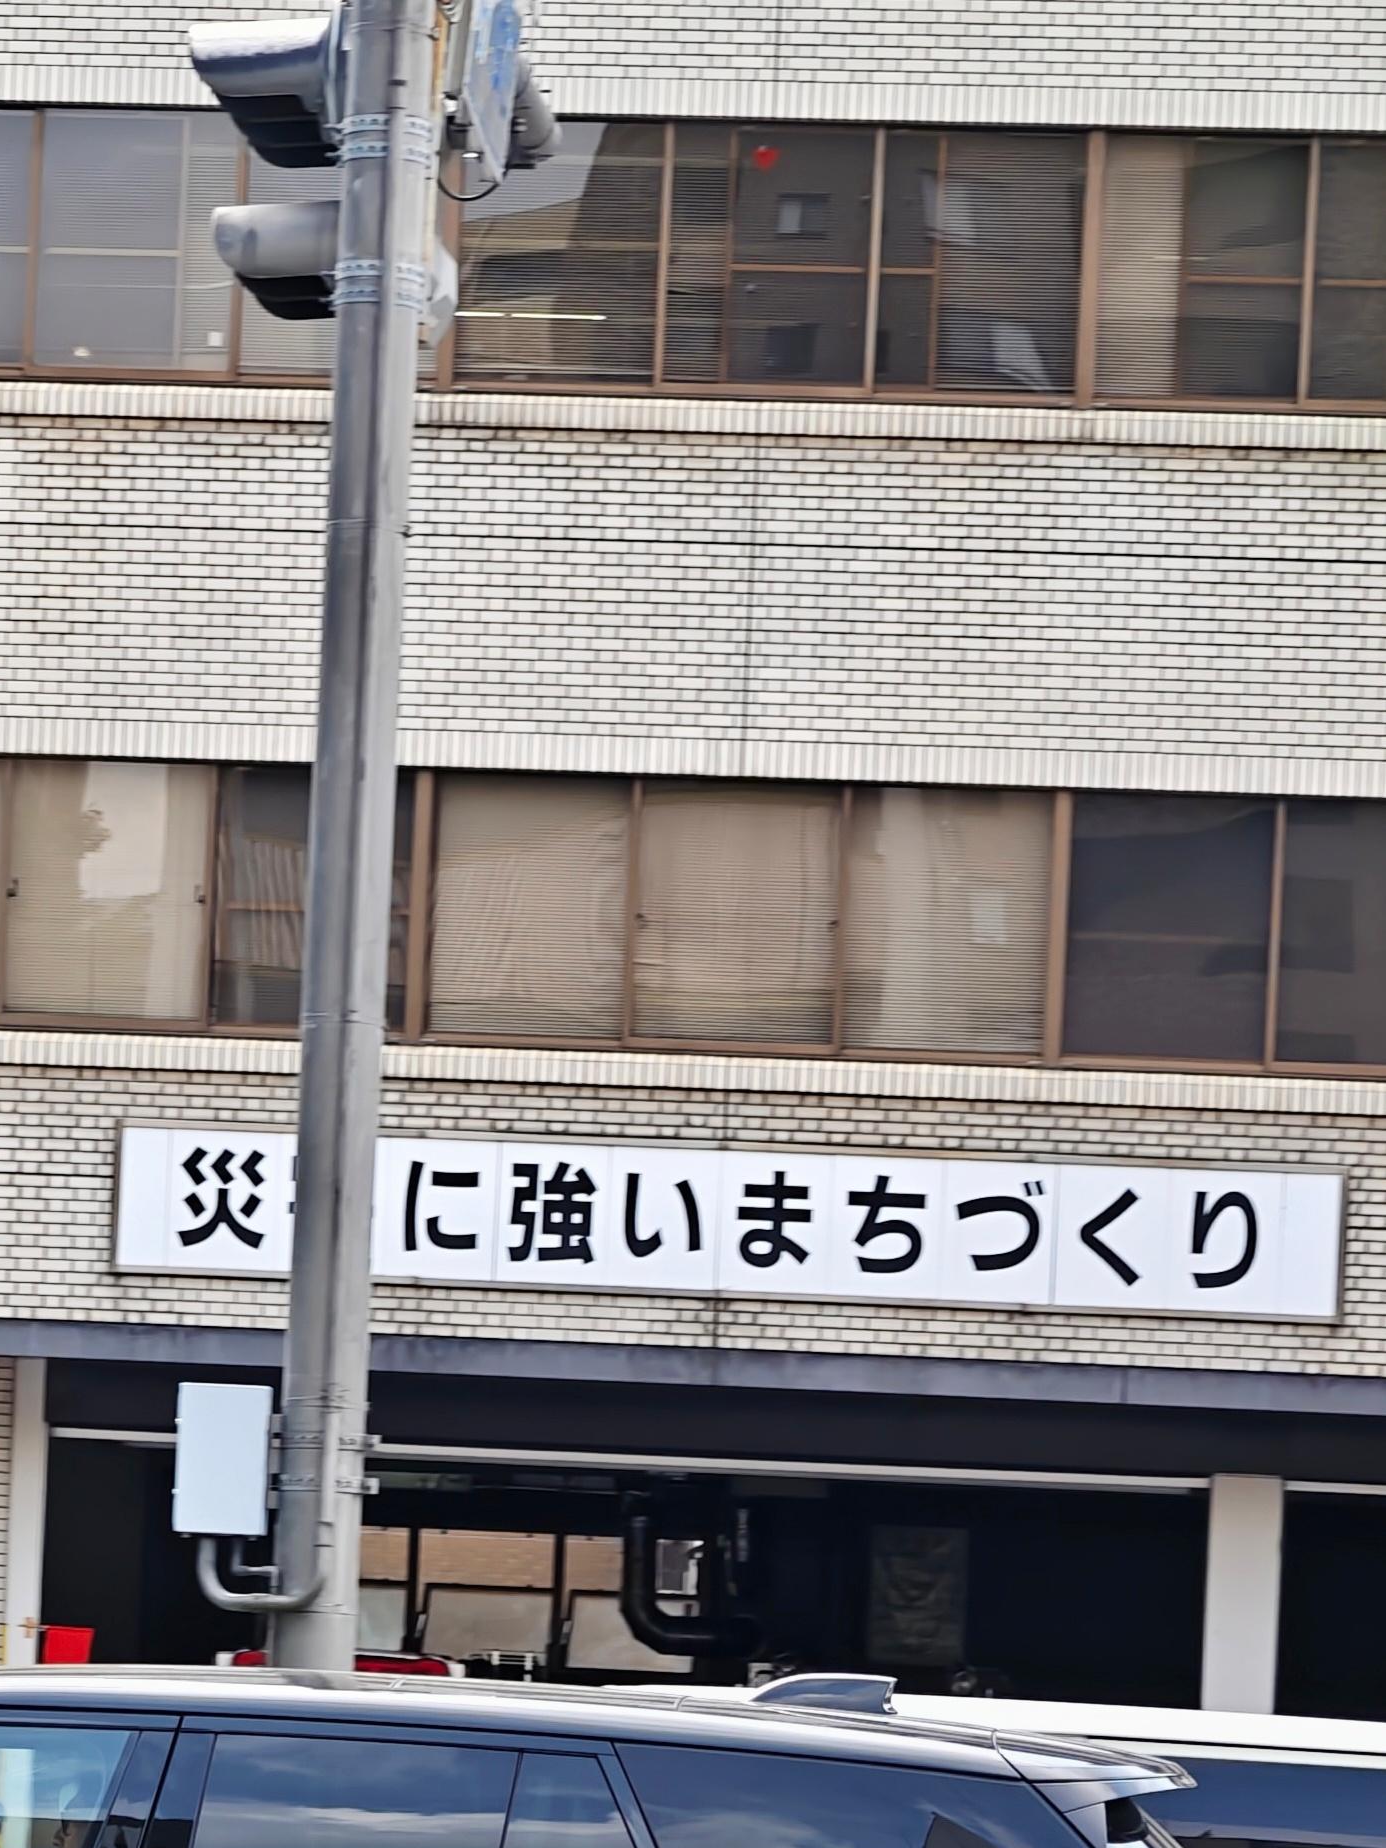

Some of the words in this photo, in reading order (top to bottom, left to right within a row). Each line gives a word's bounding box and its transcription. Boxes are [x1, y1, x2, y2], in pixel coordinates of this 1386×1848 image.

[176, 1145, 1259, 1290] 災に強いまちづくり
